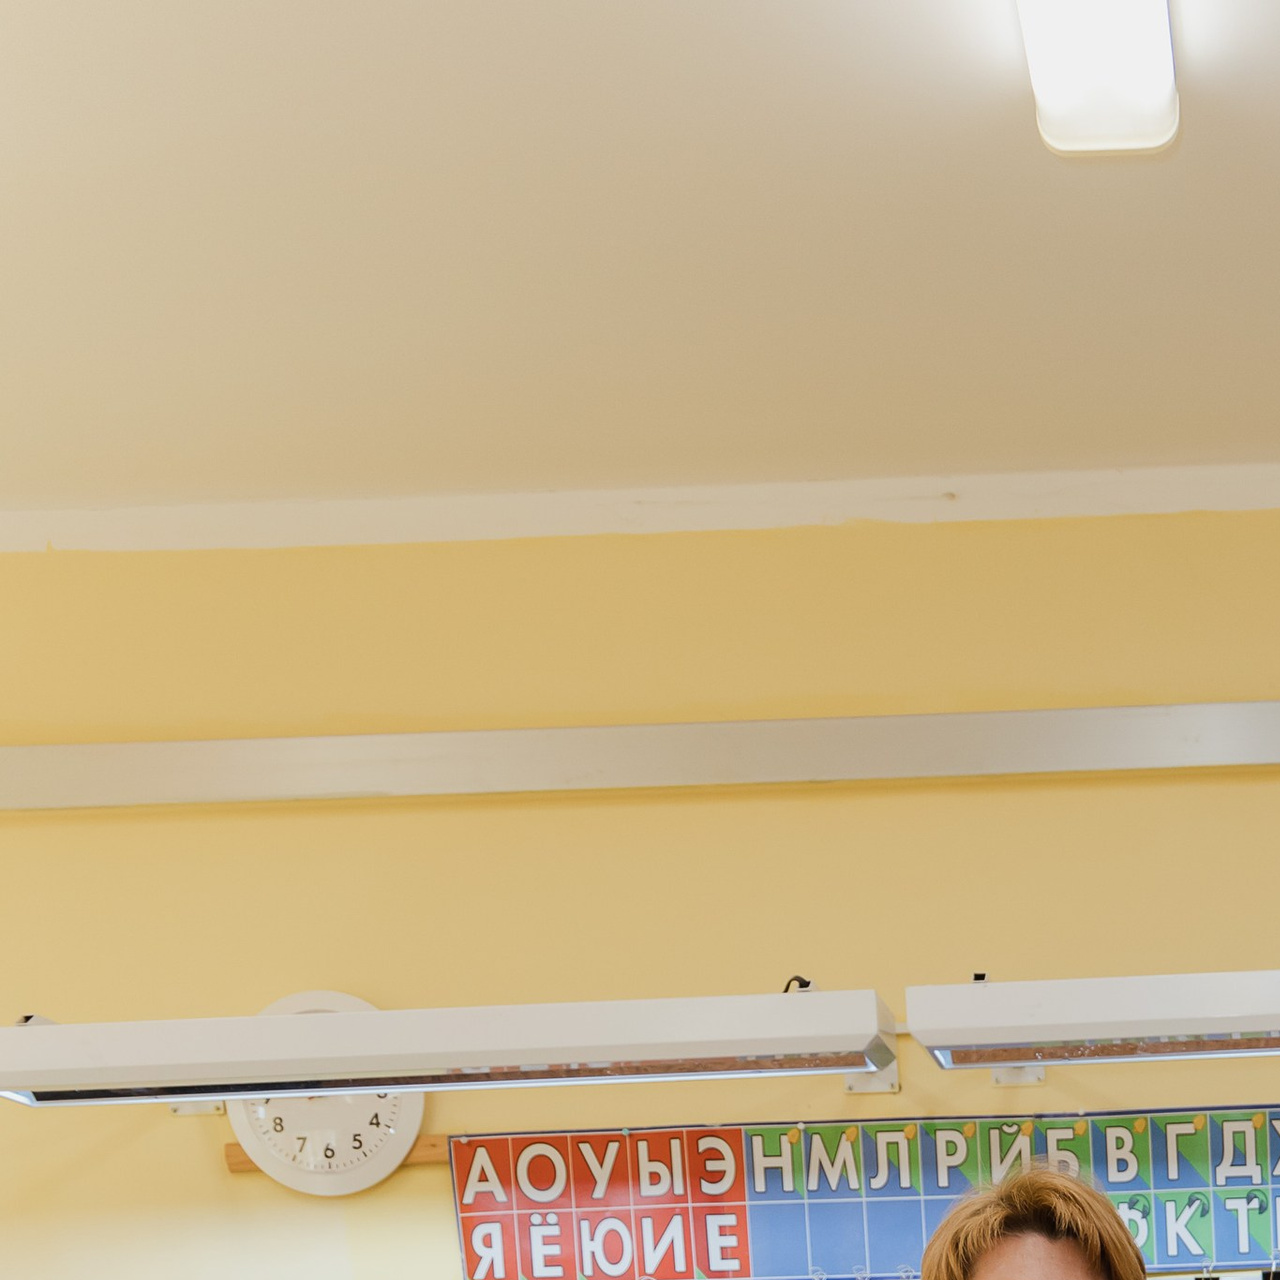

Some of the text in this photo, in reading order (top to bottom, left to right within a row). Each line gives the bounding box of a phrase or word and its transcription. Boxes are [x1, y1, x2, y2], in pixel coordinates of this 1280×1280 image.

[273, 1117, 284, 1132] 8
[369, 1113, 380, 1128] 4
[297, 1137, 307, 1152] 7
[353, 1134, 363, 1150] 5
[324, 1143, 335, 1158] 6
